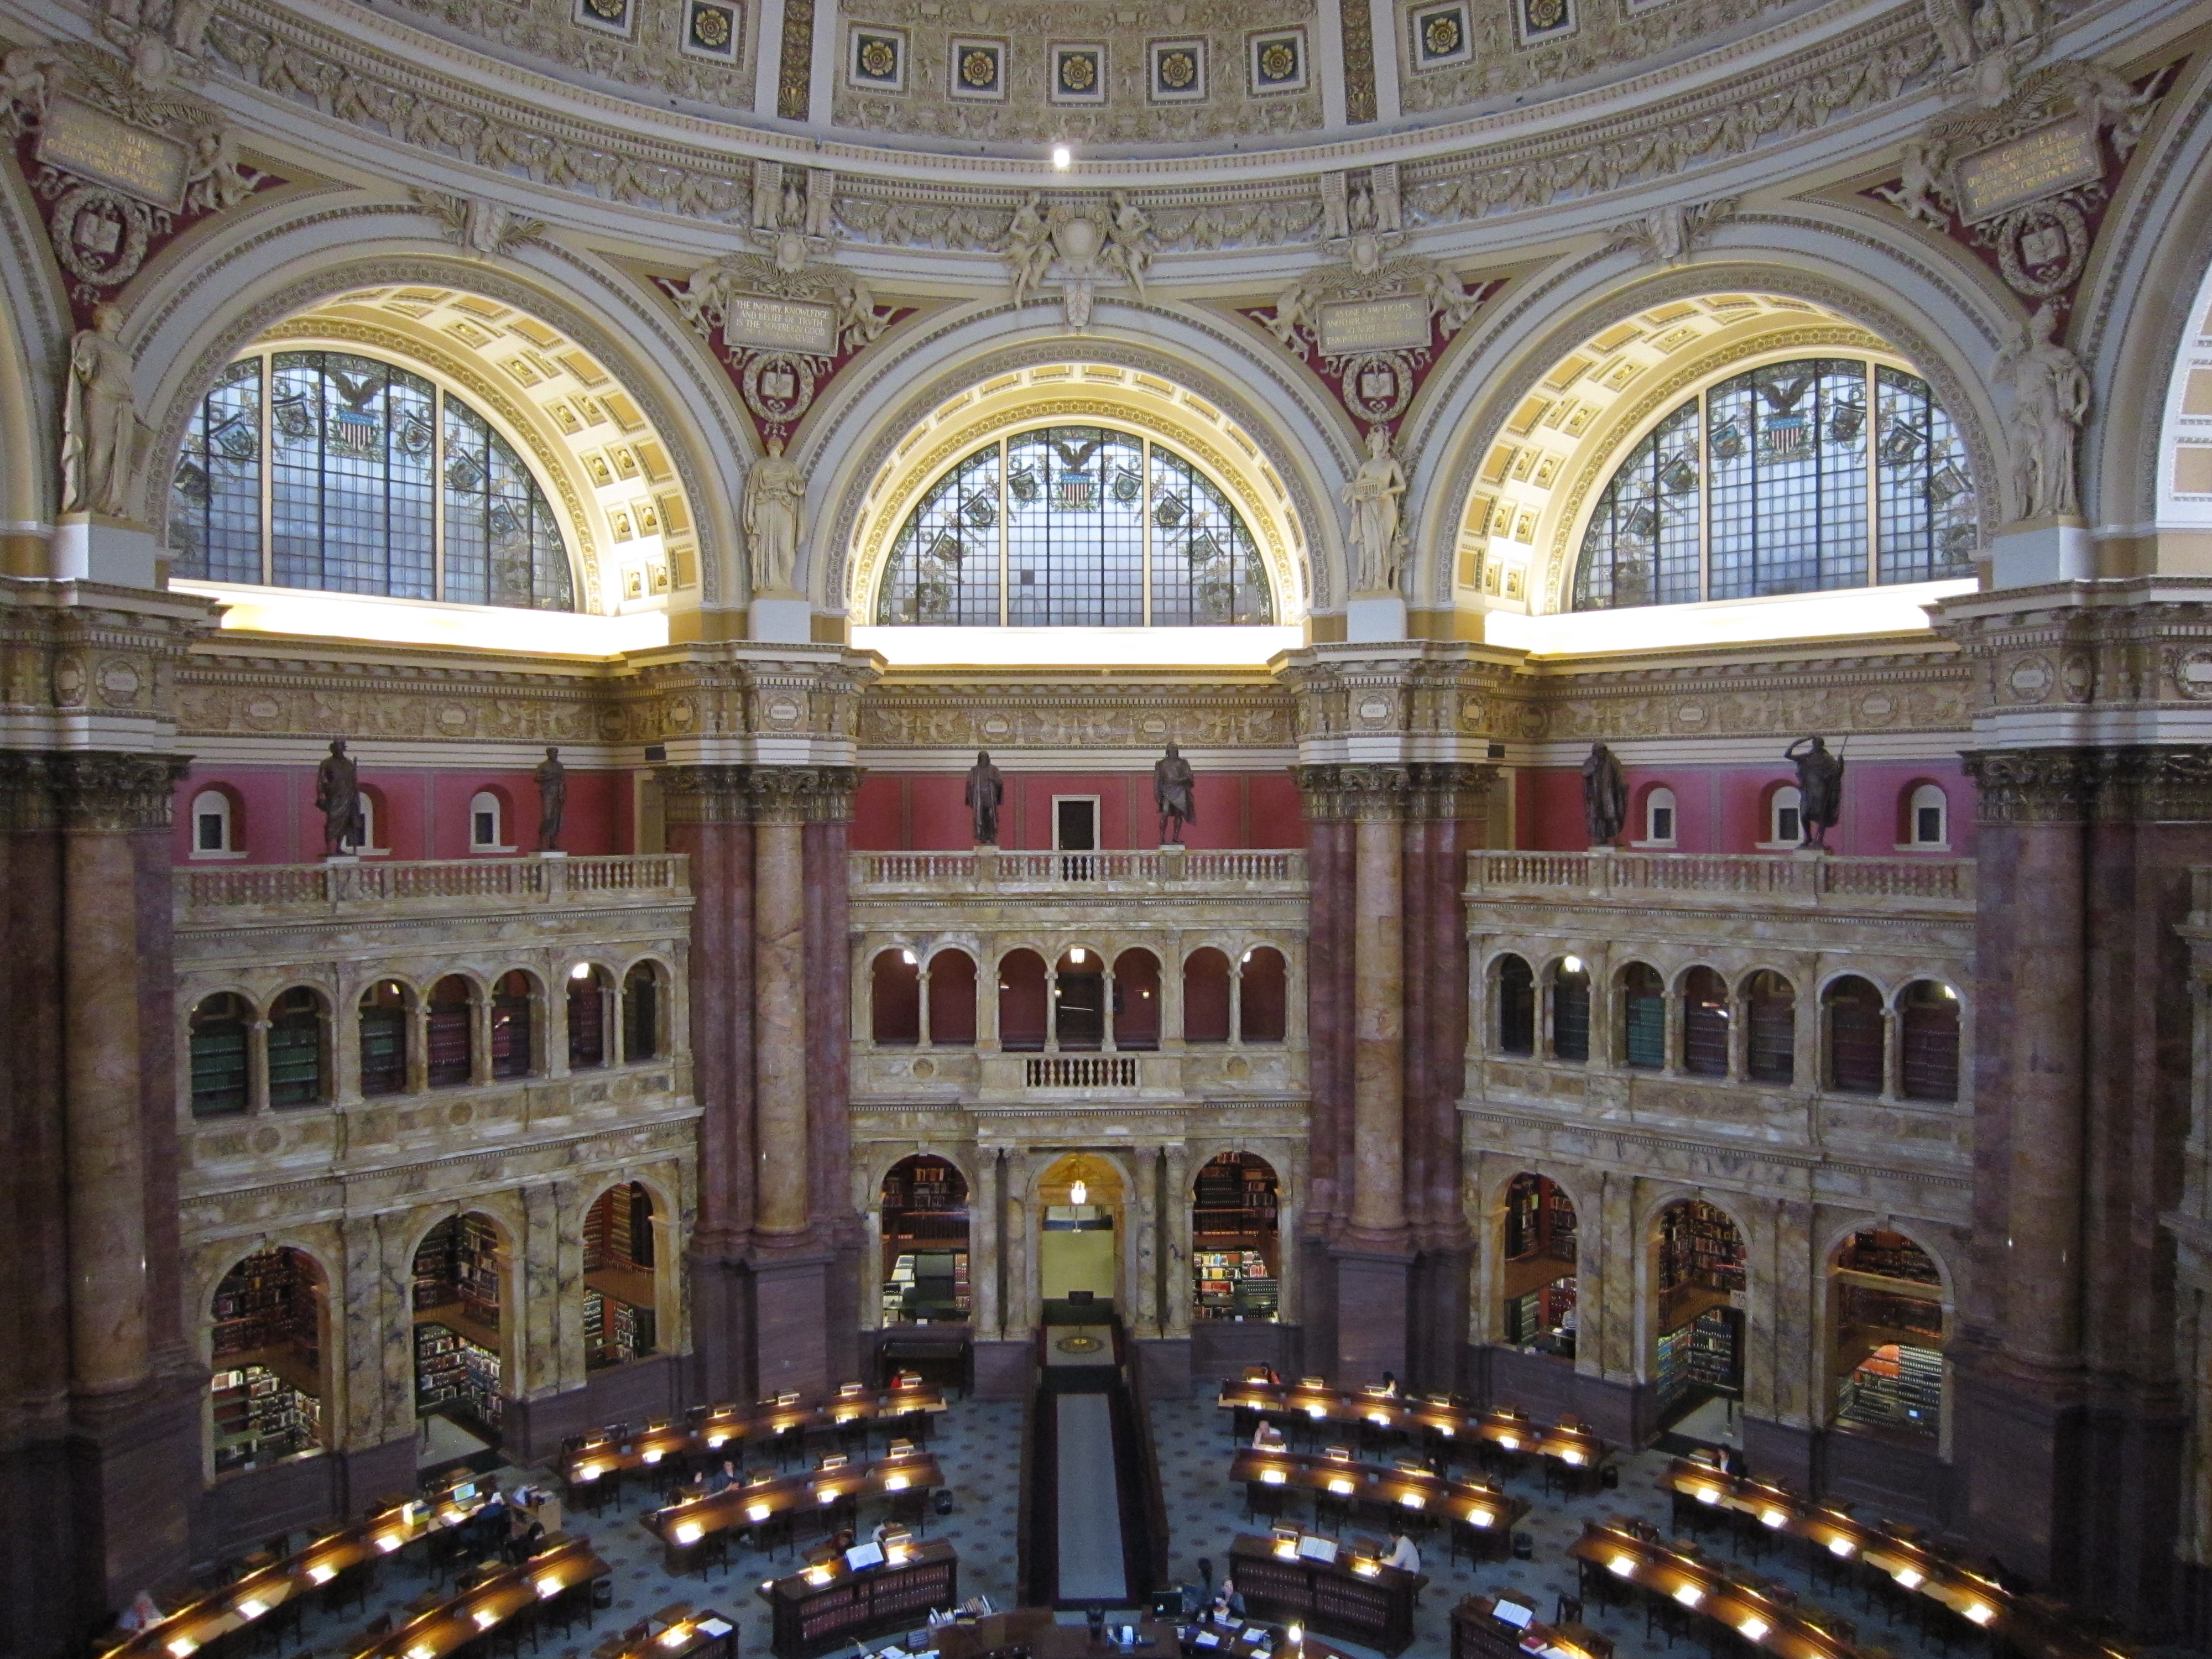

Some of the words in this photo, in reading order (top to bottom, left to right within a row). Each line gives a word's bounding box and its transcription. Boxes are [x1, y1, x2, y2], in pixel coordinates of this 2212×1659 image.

[736, 300, 750, 309] THE
[1363, 306, 1381, 314] LAMP
[1384, 303, 1411, 312] LIGHTS
[740, 310, 756, 319] AND
[759, 313, 782, 322] BELIEF
[799, 317, 823, 326] TRVTH
[805, 327, 825, 336] GOOD
